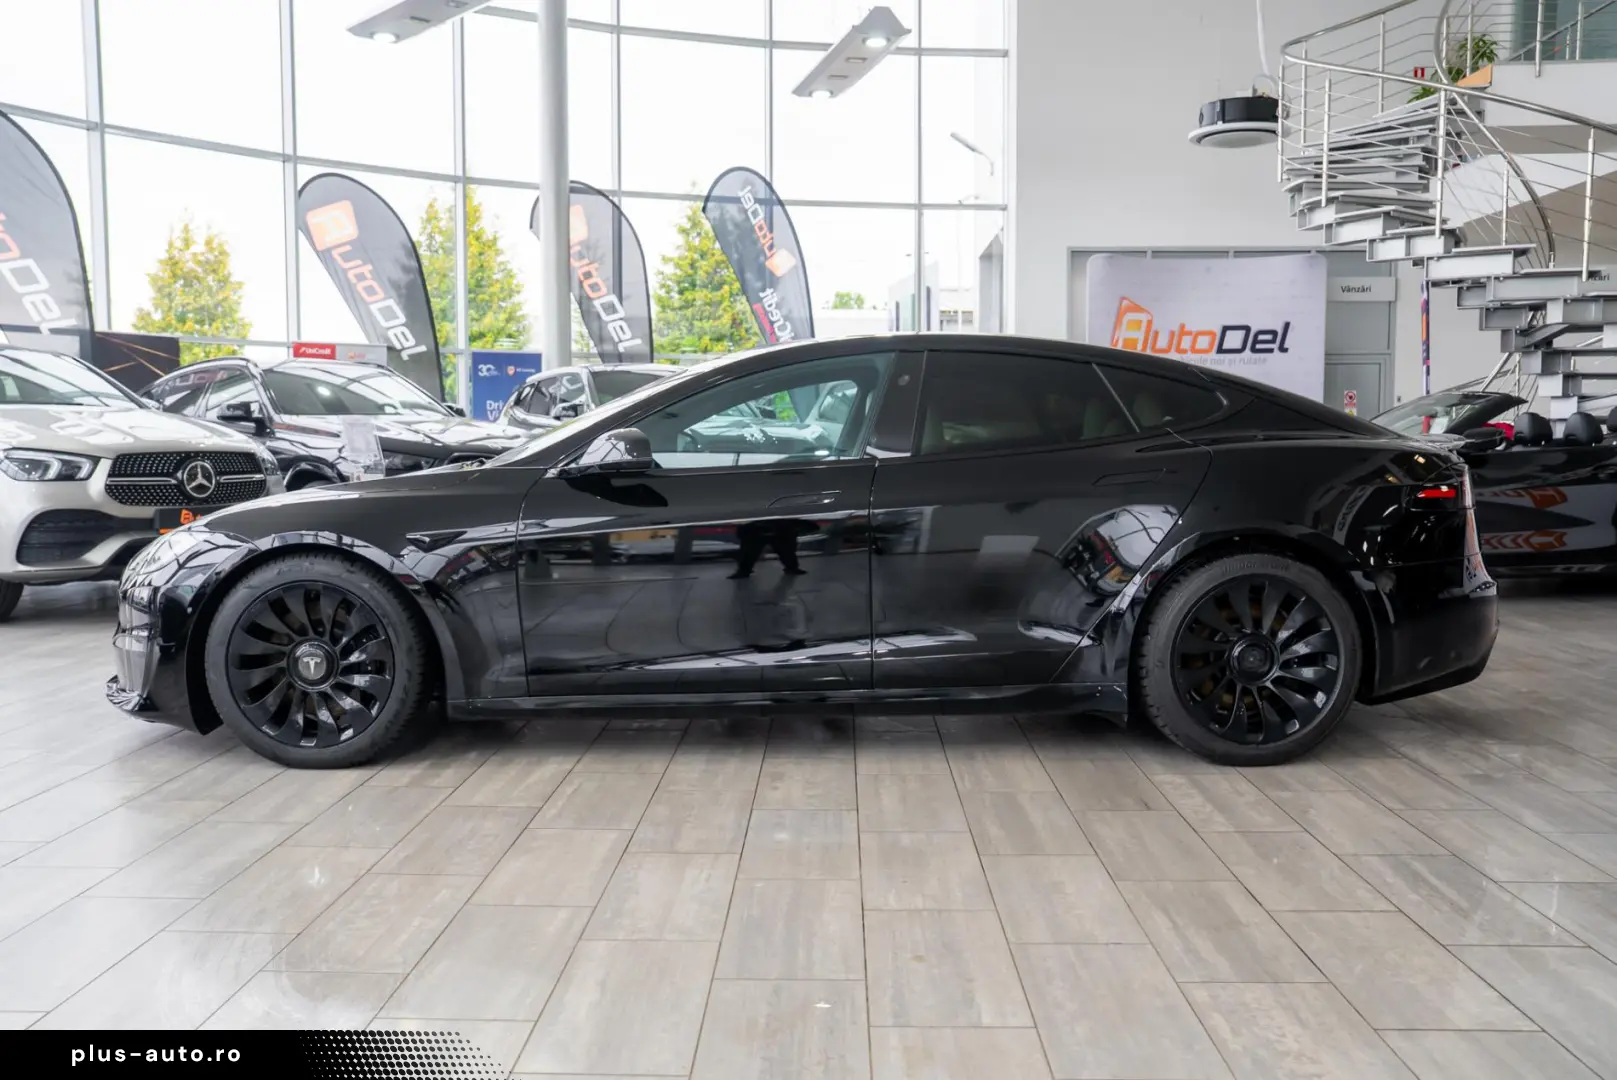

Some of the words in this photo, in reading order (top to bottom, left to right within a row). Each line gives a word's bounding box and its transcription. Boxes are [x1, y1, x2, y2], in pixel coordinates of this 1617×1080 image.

[306, 200, 427, 361] AutoDel
[1340, 284, 1372, 293] Vânzări
[1110, 297, 1291, 354] AutoDel
